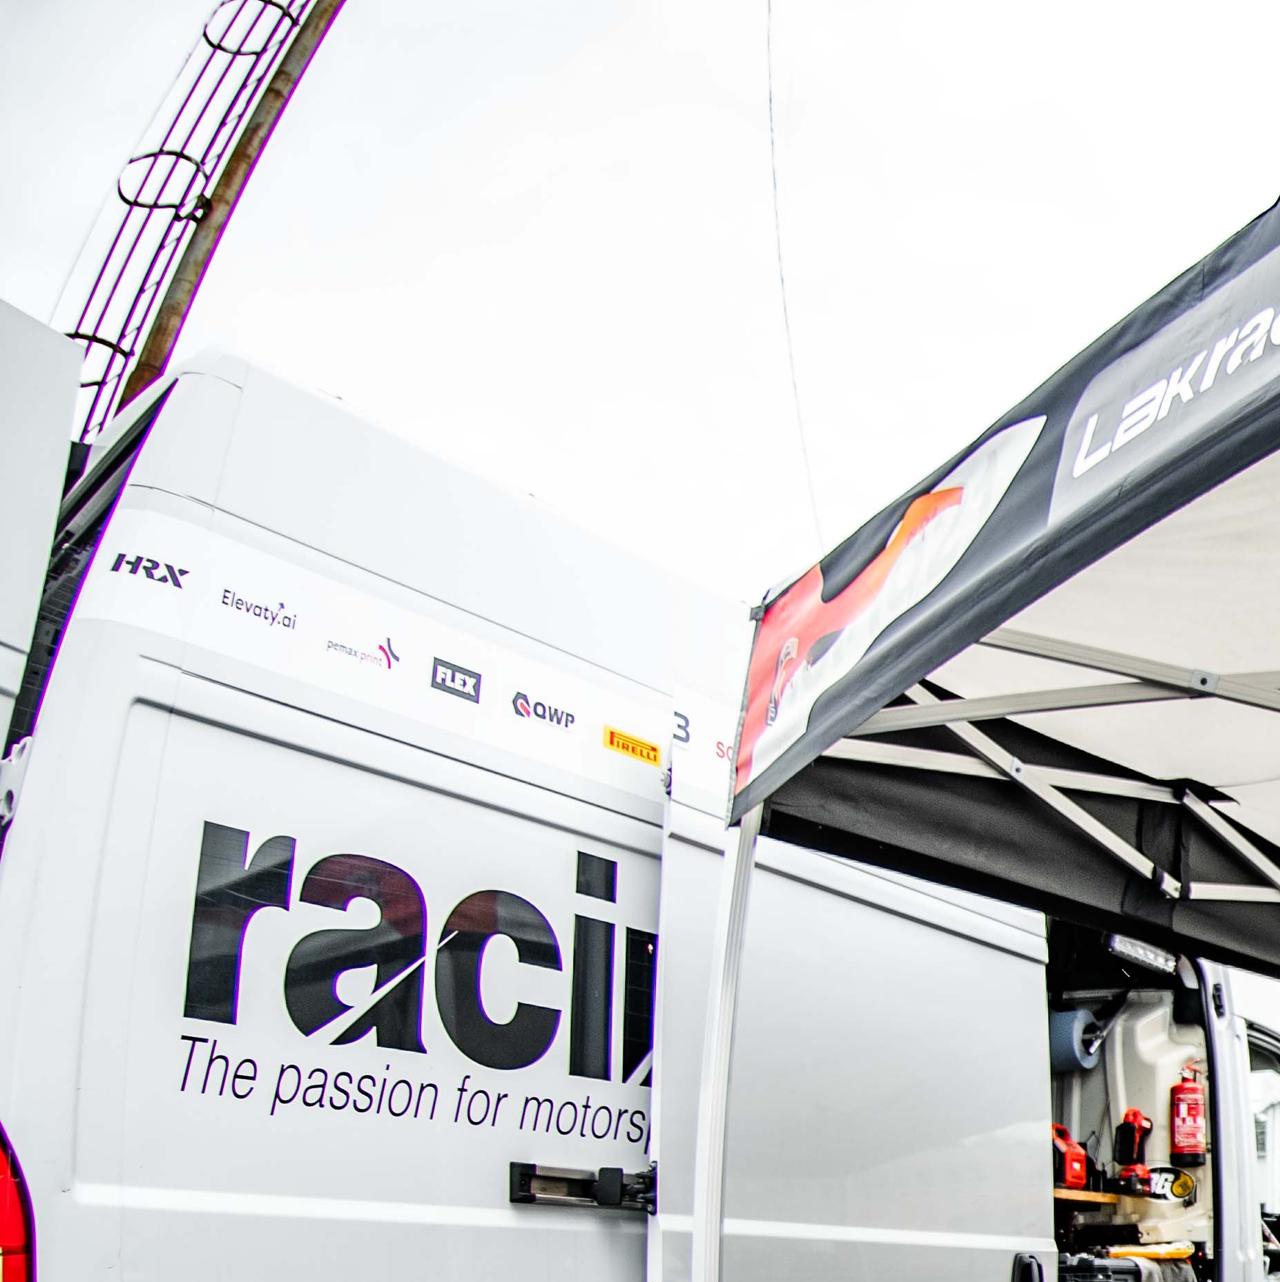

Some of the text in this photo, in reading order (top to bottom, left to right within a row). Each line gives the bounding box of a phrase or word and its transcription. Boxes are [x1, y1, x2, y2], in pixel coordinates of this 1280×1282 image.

[110, 552, 190, 589] HRX
[221, 589, 297, 630] Elevaty.ai
[435, 665, 477, 697] FLEX
[533, 701, 575, 729] QWP
[609, 731, 658, 764] PIRELLI
[179, 1034, 652, 1156] The passion for motors
